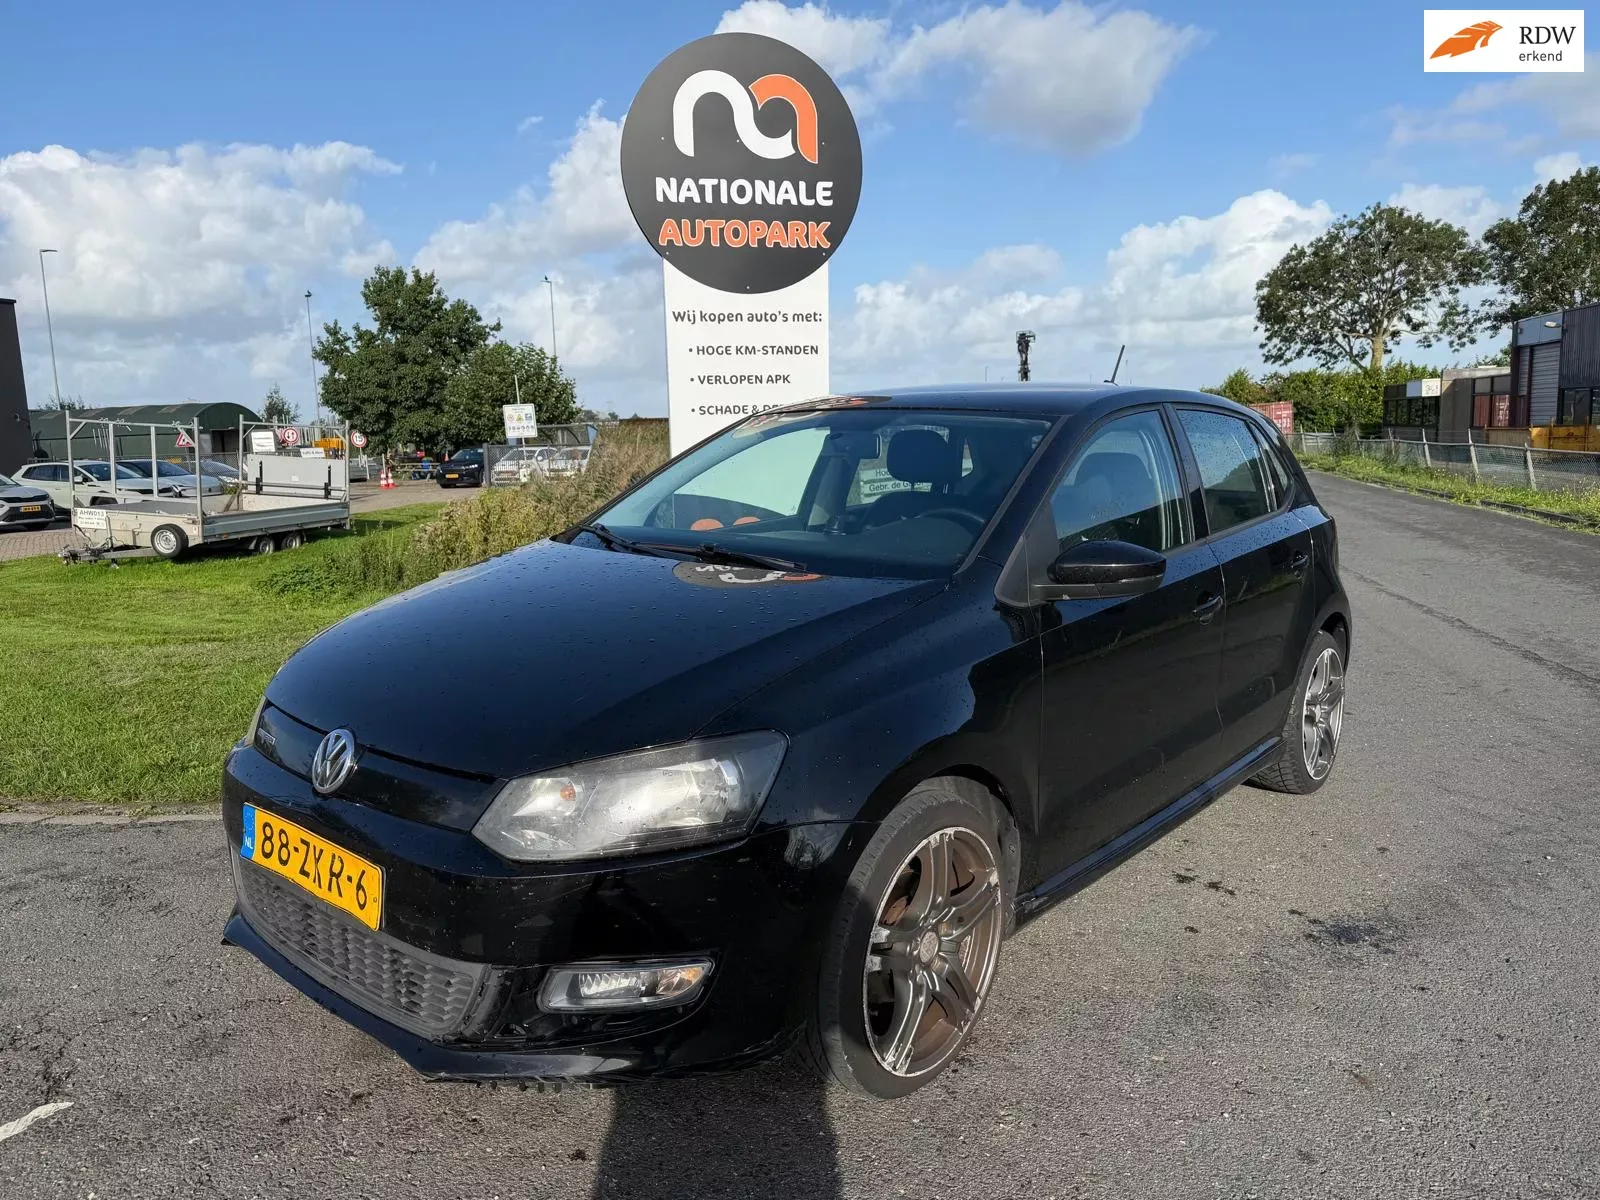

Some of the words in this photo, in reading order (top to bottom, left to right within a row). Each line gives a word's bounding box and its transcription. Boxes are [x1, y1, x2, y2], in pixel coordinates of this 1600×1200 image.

[655, 176, 834, 207] NATIONALE
[658, 218, 832, 249] AUTOPARK
[672, 310, 696, 325] Wij
[699, 310, 744, 325] kopen
[747, 310, 789, 323] auto's
[792, 311, 823, 323] met:
[696, 345, 732, 356] HOGE
[735, 345, 819, 356] KM-STANDEN
[698, 374, 763, 385] VERLOPEN
[766, 374, 791, 385] APK
[699, 404, 749, 416] SCHADE
[244, 835, 254, 850] NL
[261, 821, 368, 910] 88-ZXR-6
